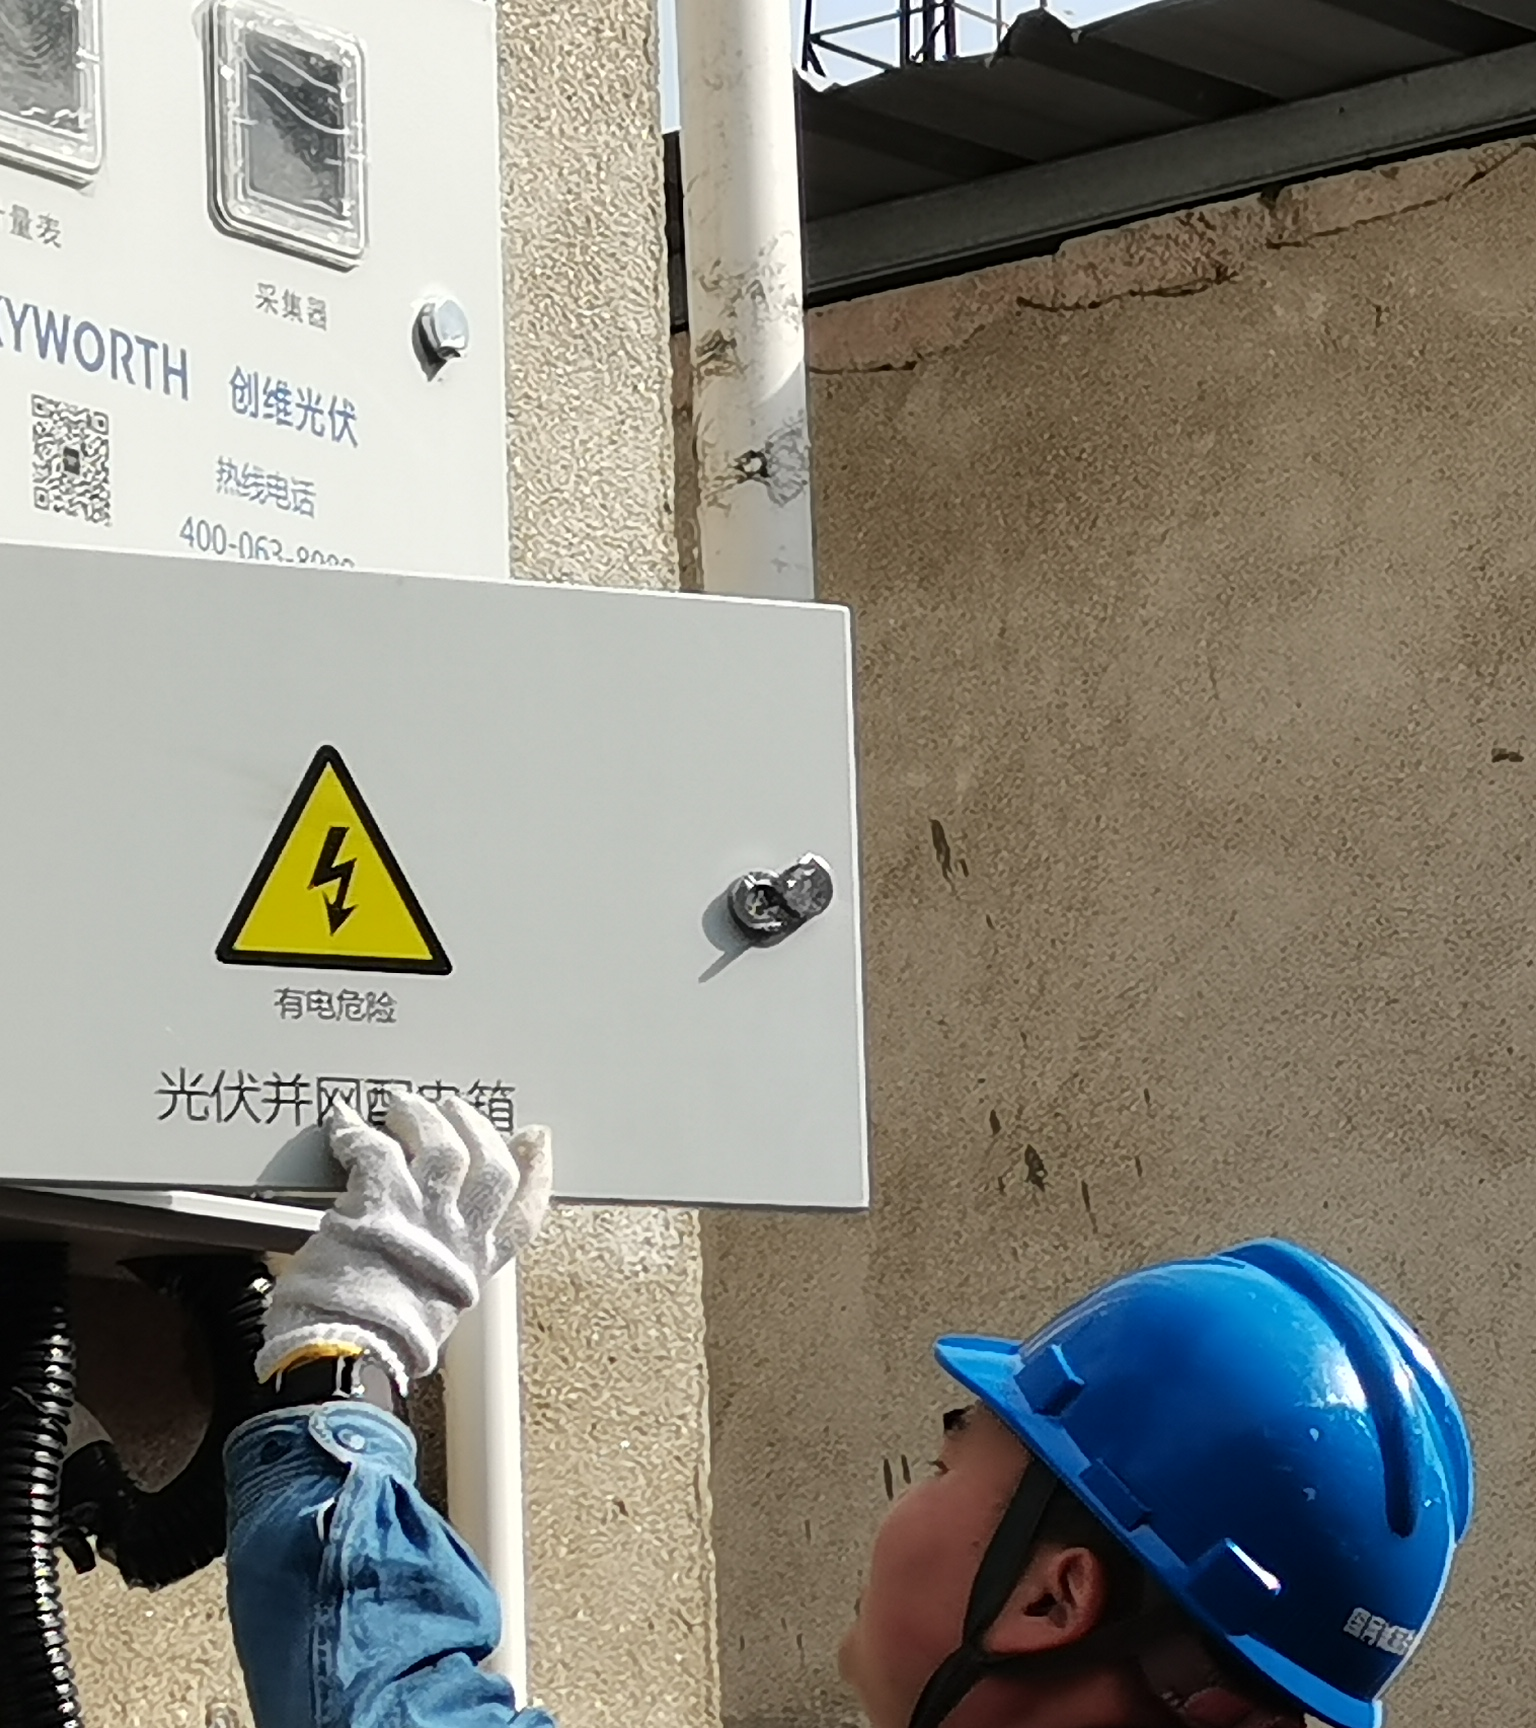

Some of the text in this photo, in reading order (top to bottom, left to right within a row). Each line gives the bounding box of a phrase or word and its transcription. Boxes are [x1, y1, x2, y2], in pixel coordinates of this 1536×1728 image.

[254, 282, 329, 332] 采集器
[229, 365, 359, 448] 创维光伏
[216, 455, 317, 519] 热线电话
[273, 987, 398, 1024] 有电危险
